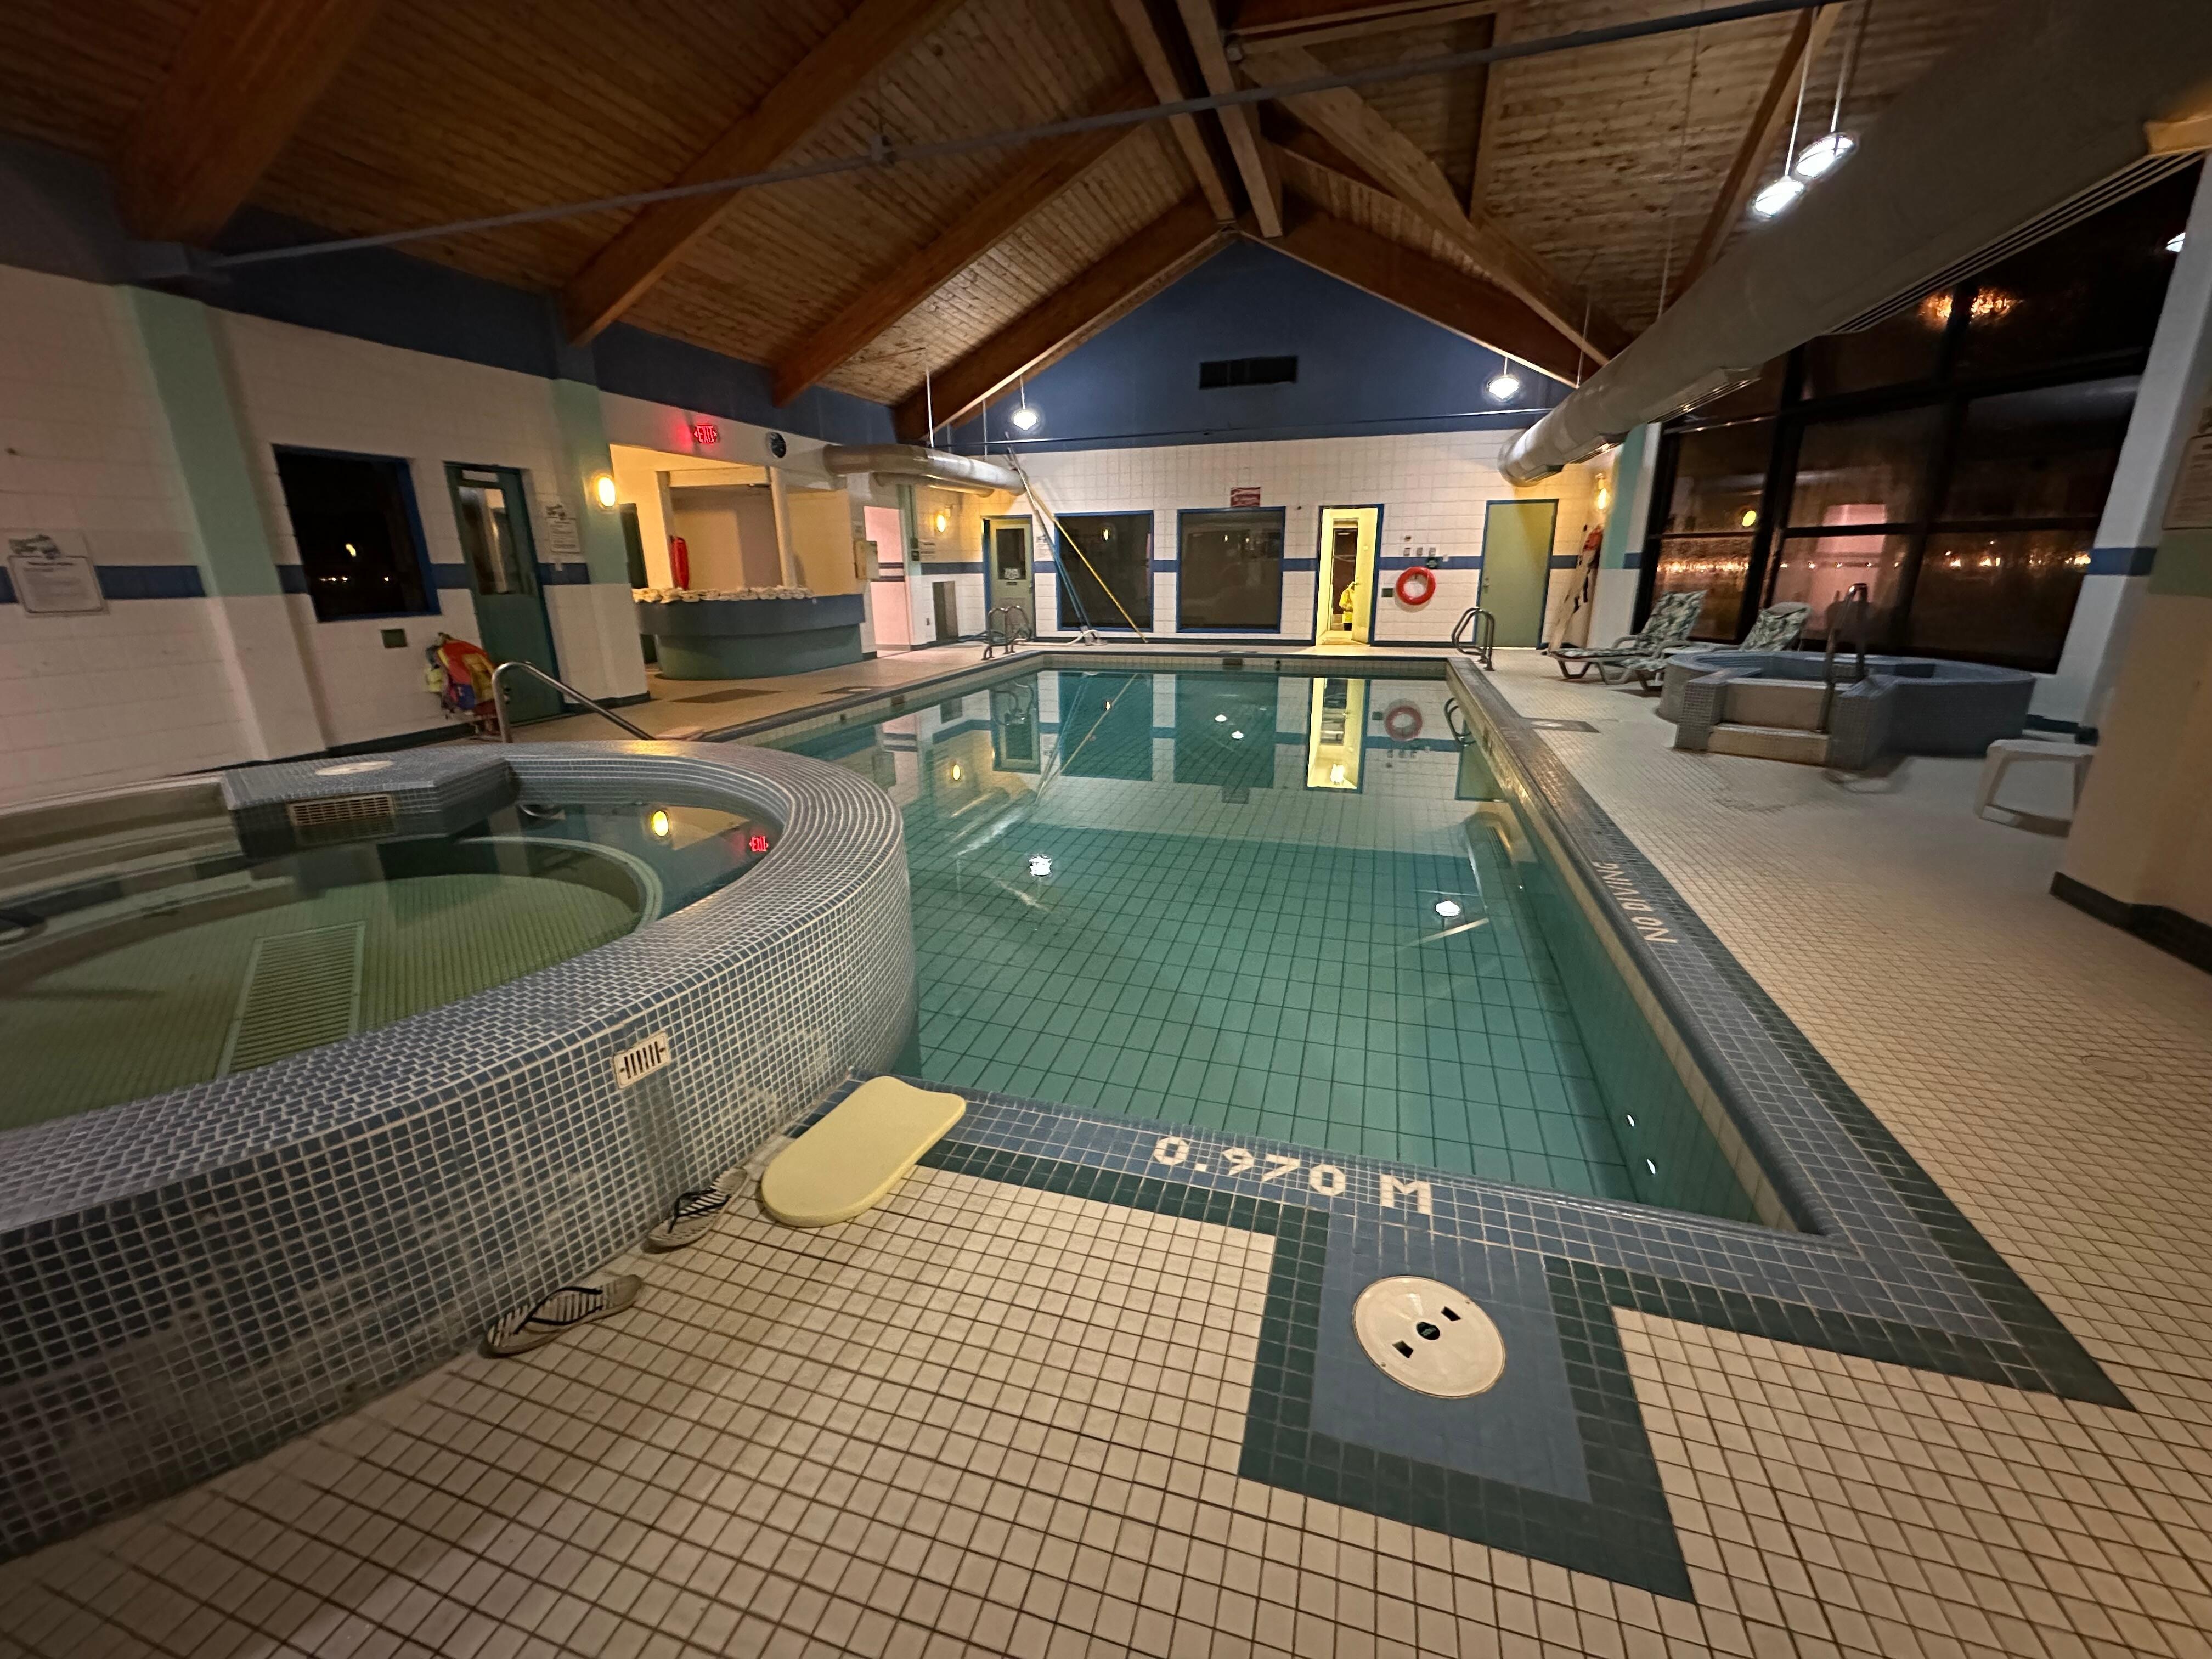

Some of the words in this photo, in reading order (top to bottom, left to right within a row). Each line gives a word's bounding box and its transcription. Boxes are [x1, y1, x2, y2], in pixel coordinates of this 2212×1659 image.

[696, 425, 714, 443] EXIT
[1592, 861, 1654, 912] DIVING
[1631, 916, 1678, 944] NO
[1153, 1135, 1346, 1197] 0.970
[1380, 1174, 1432, 1215] M
